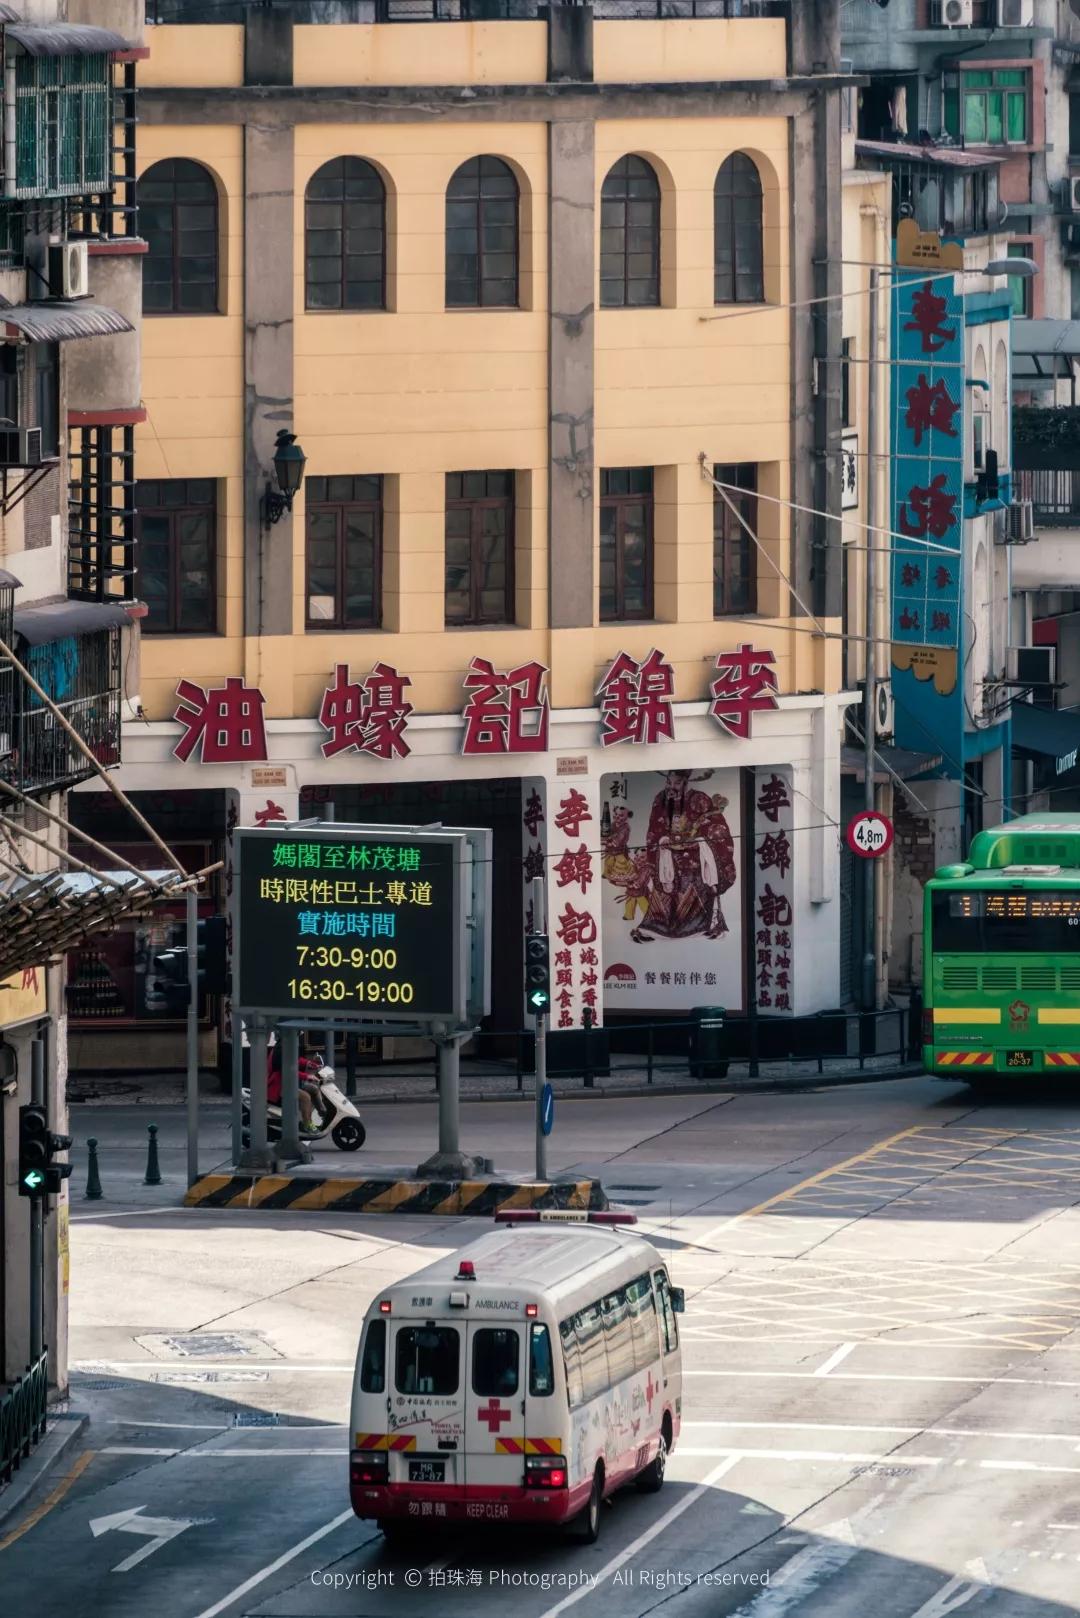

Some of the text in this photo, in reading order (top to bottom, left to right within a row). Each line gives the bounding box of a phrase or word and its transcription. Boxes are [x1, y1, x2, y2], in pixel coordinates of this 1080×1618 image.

[272, 843, 421, 872] 媽閣至林茂塘
[756, 774, 793, 926] 李錦記
[553, 788, 597, 946] 李錦記
[259, 878, 434, 906] 時限性巴士專道
[297, 910, 396, 938] 實施時間
[1068, 918, 1080, 926] 60
[295, 945, 398, 970] 7:30-9:00
[287, 978, 414, 1004] 16:30-19:00
[645, 971, 717, 986] 餐餐陪伴您
[475, 1300, 520, 1310] AMBULANCE
[466, 1502, 508, 1518] KEEP CLEAR
